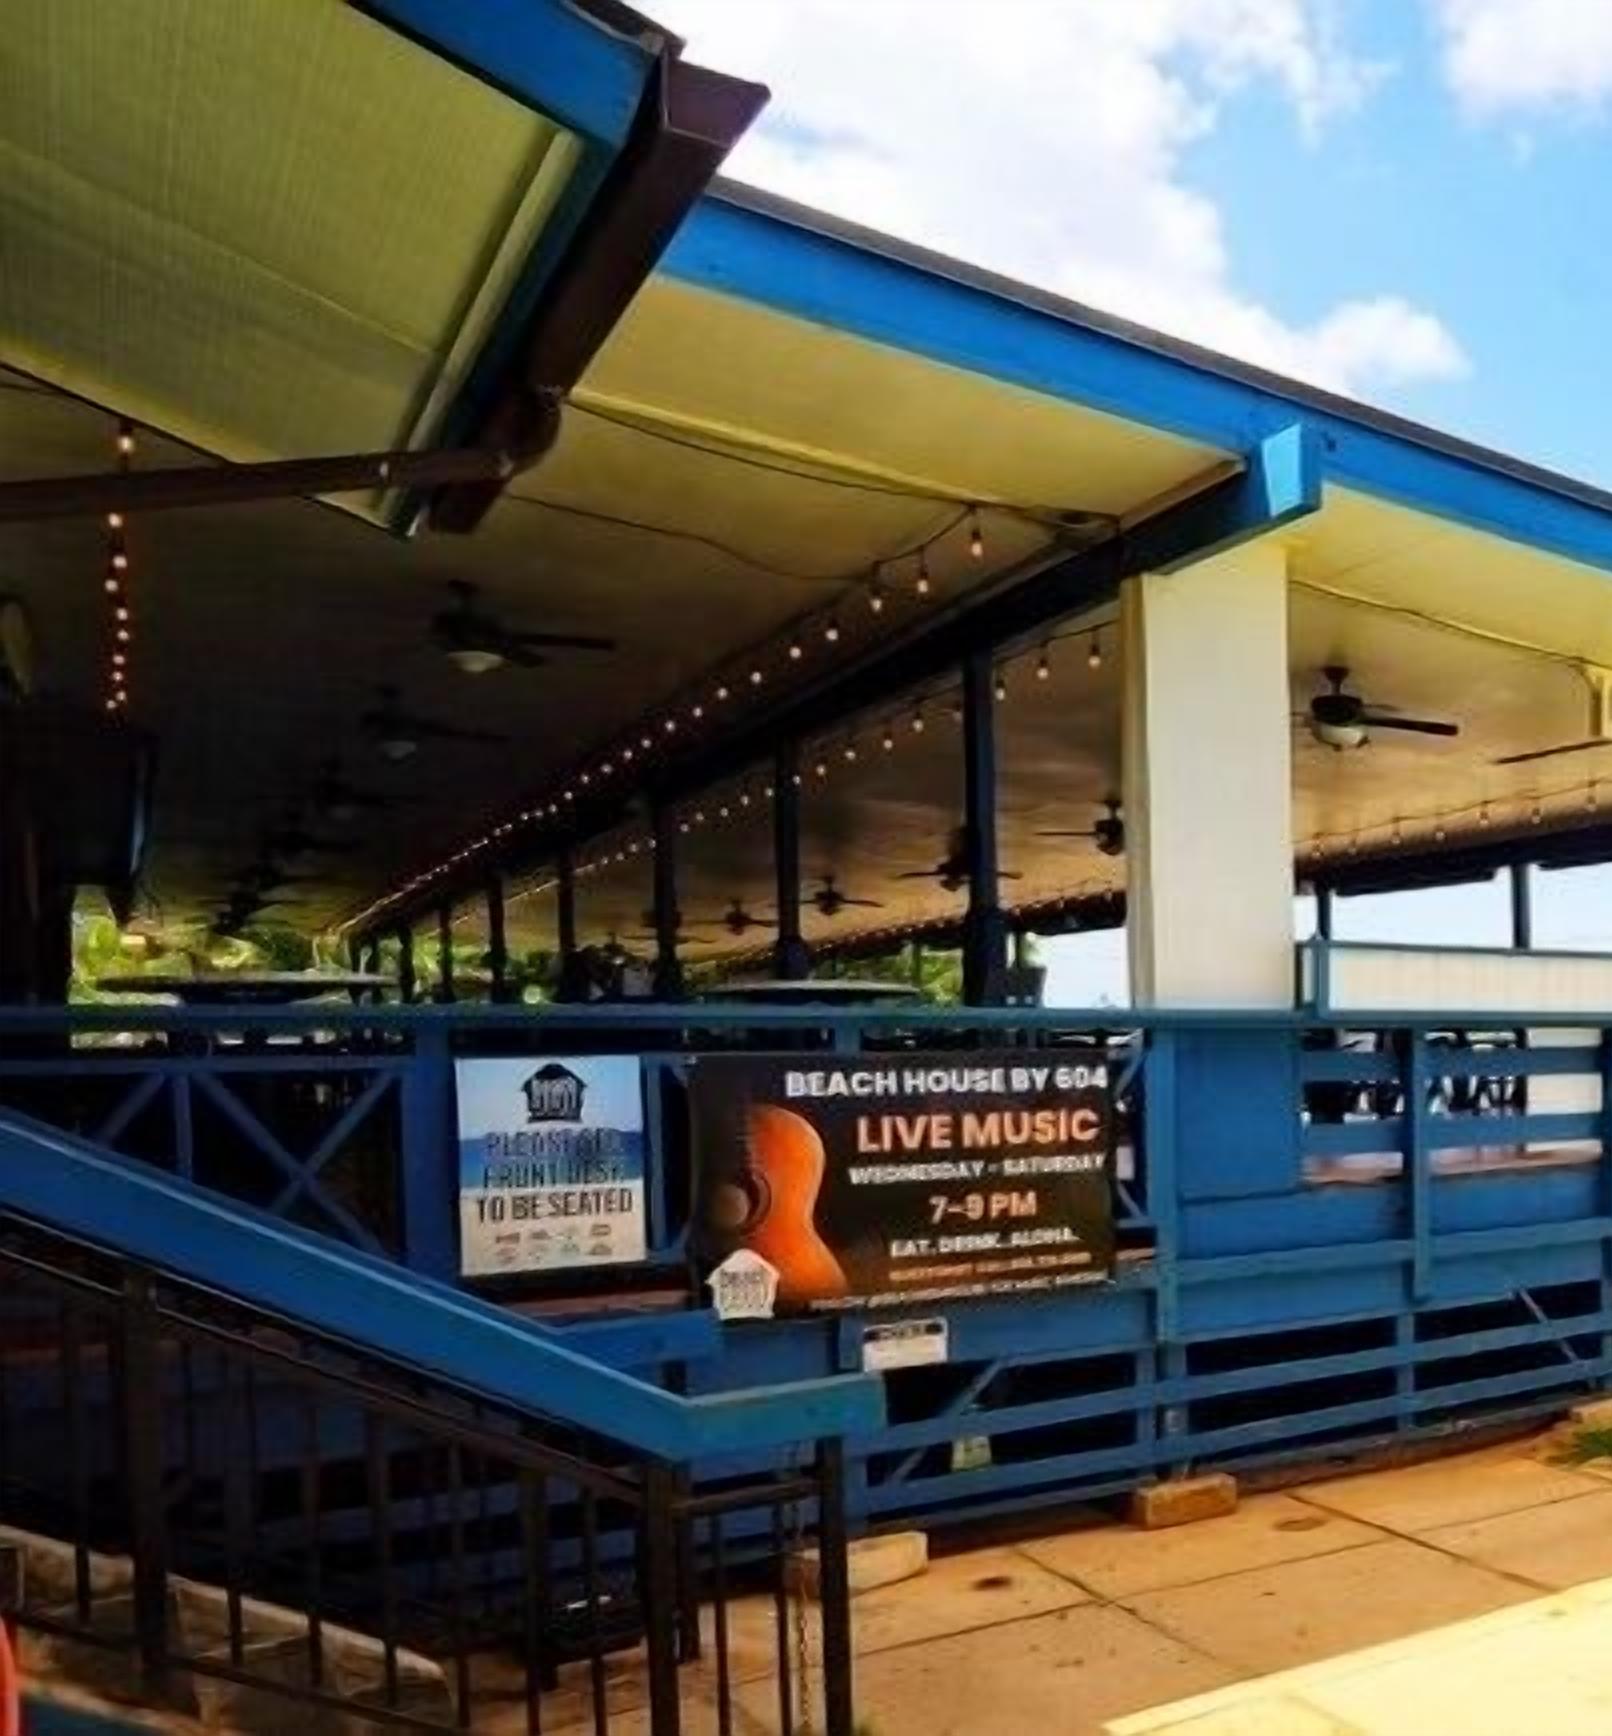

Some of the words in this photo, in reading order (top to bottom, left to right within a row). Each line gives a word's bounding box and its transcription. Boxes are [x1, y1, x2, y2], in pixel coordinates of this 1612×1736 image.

[785, 1070, 898, 1097] BEACH
[903, 1067, 1005, 1094] HOUSE
[1011, 1067, 1049, 1092] BY
[1055, 1065, 1108, 1089] 604
[857, 1114, 953, 1152] LIVE
[961, 1108, 1100, 1148] MUSIC
[848, 1160, 985, 1185] WEDNESDAY
[1003, 1153, 1106, 1176] SATURDAY
[477, 1195, 504, 1223] TO
[511, 1194, 543, 1220] BE
[548, 1187, 634, 1217] SEATED
[990, 1190, 1037, 1219] PM
